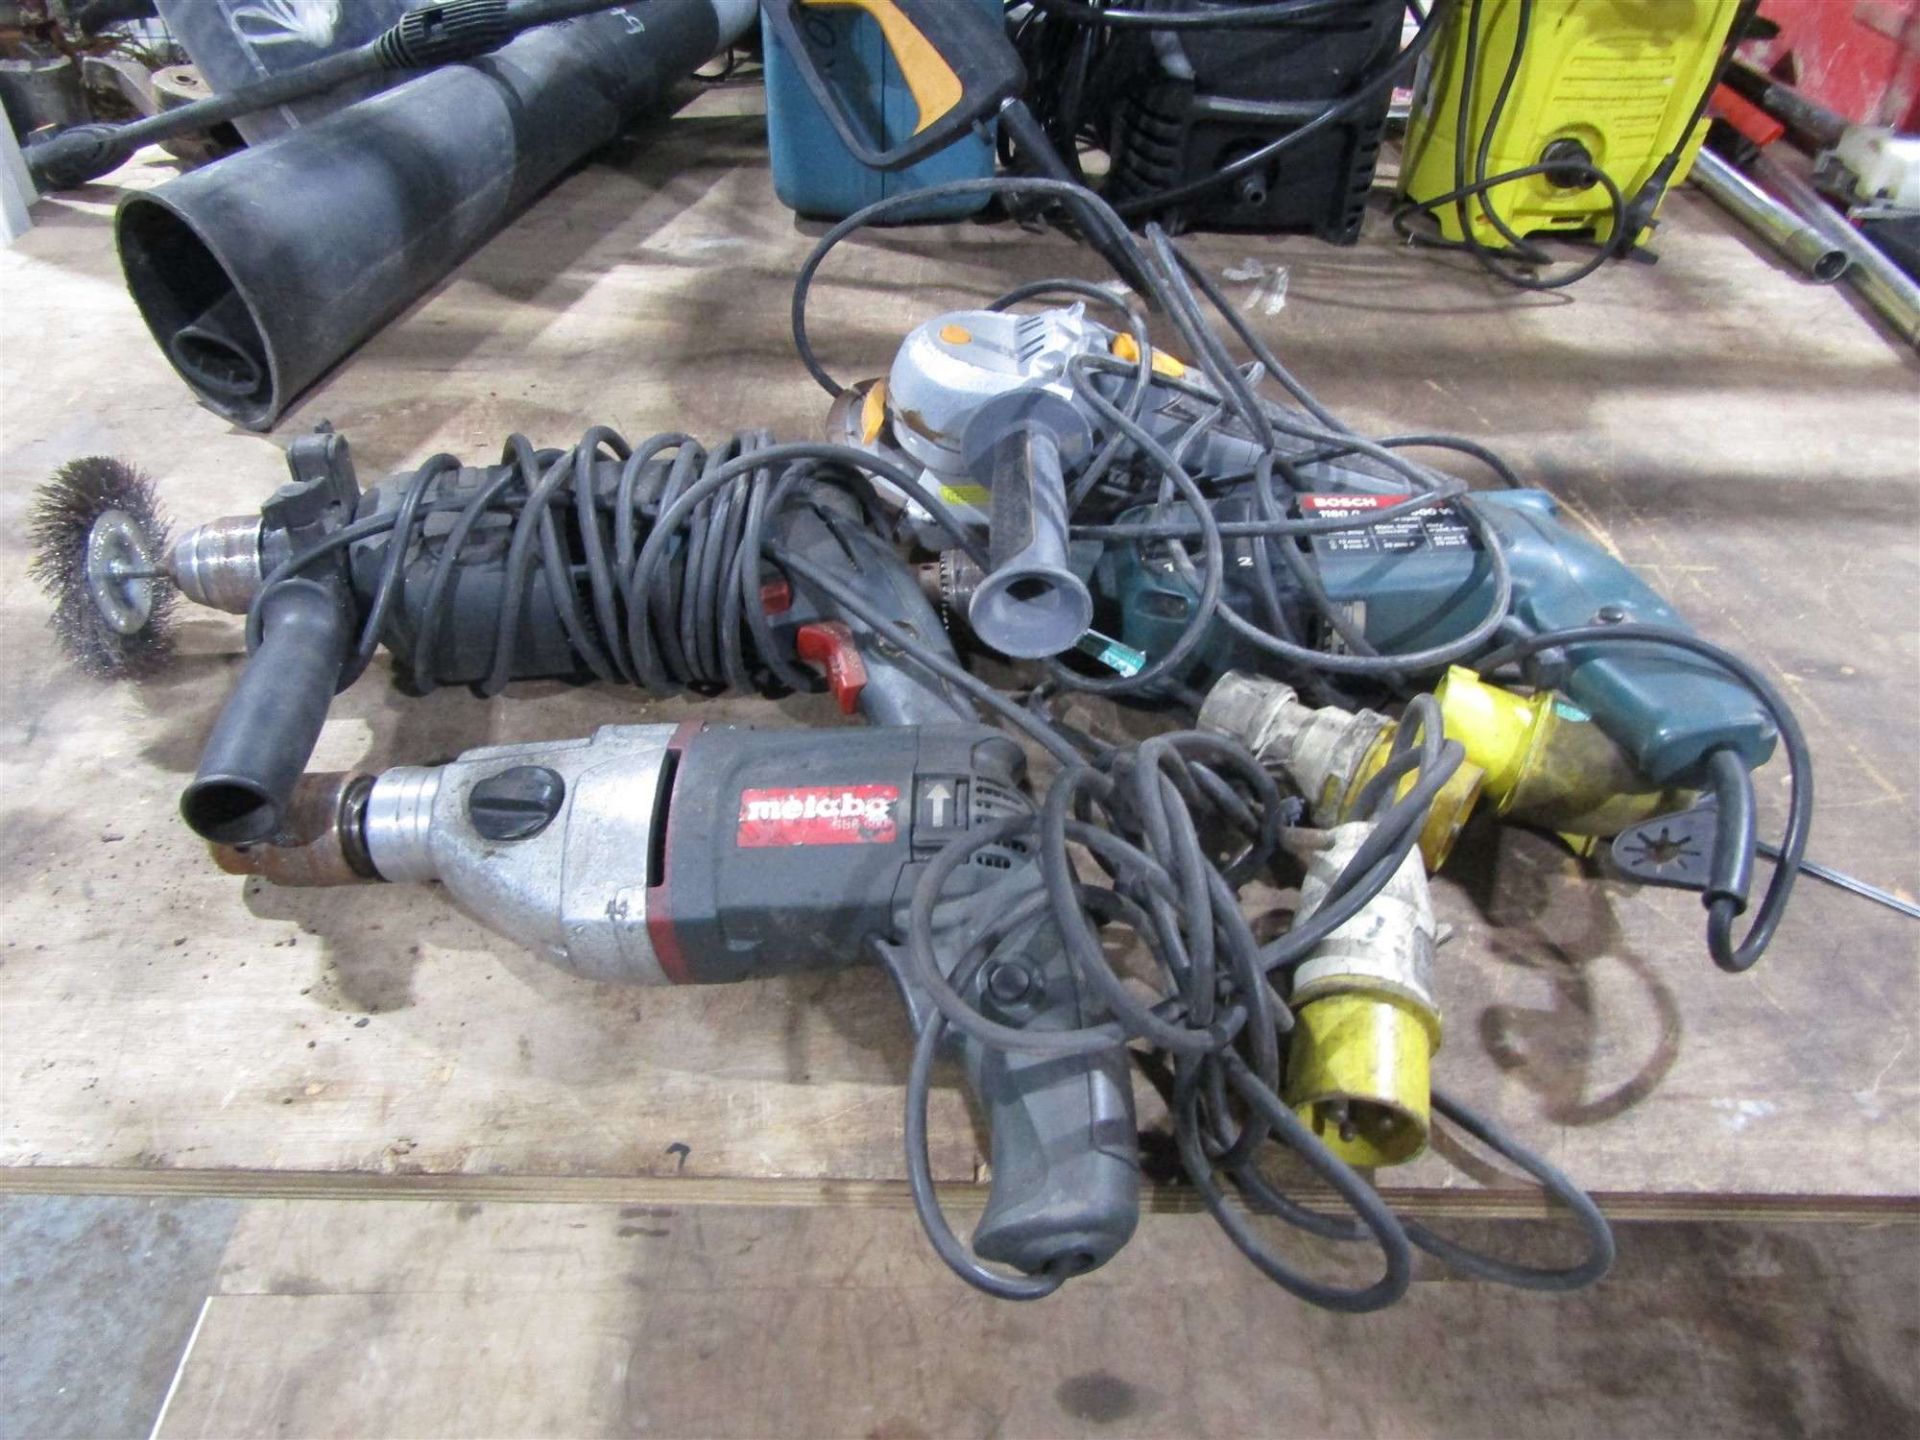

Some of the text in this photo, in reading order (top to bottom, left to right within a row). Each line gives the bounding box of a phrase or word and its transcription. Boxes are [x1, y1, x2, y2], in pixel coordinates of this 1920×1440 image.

[1313, 497, 1377, 508] BOSCH
[1237, 556, 1254, 567] 2
[1163, 562, 1175, 573] 1
